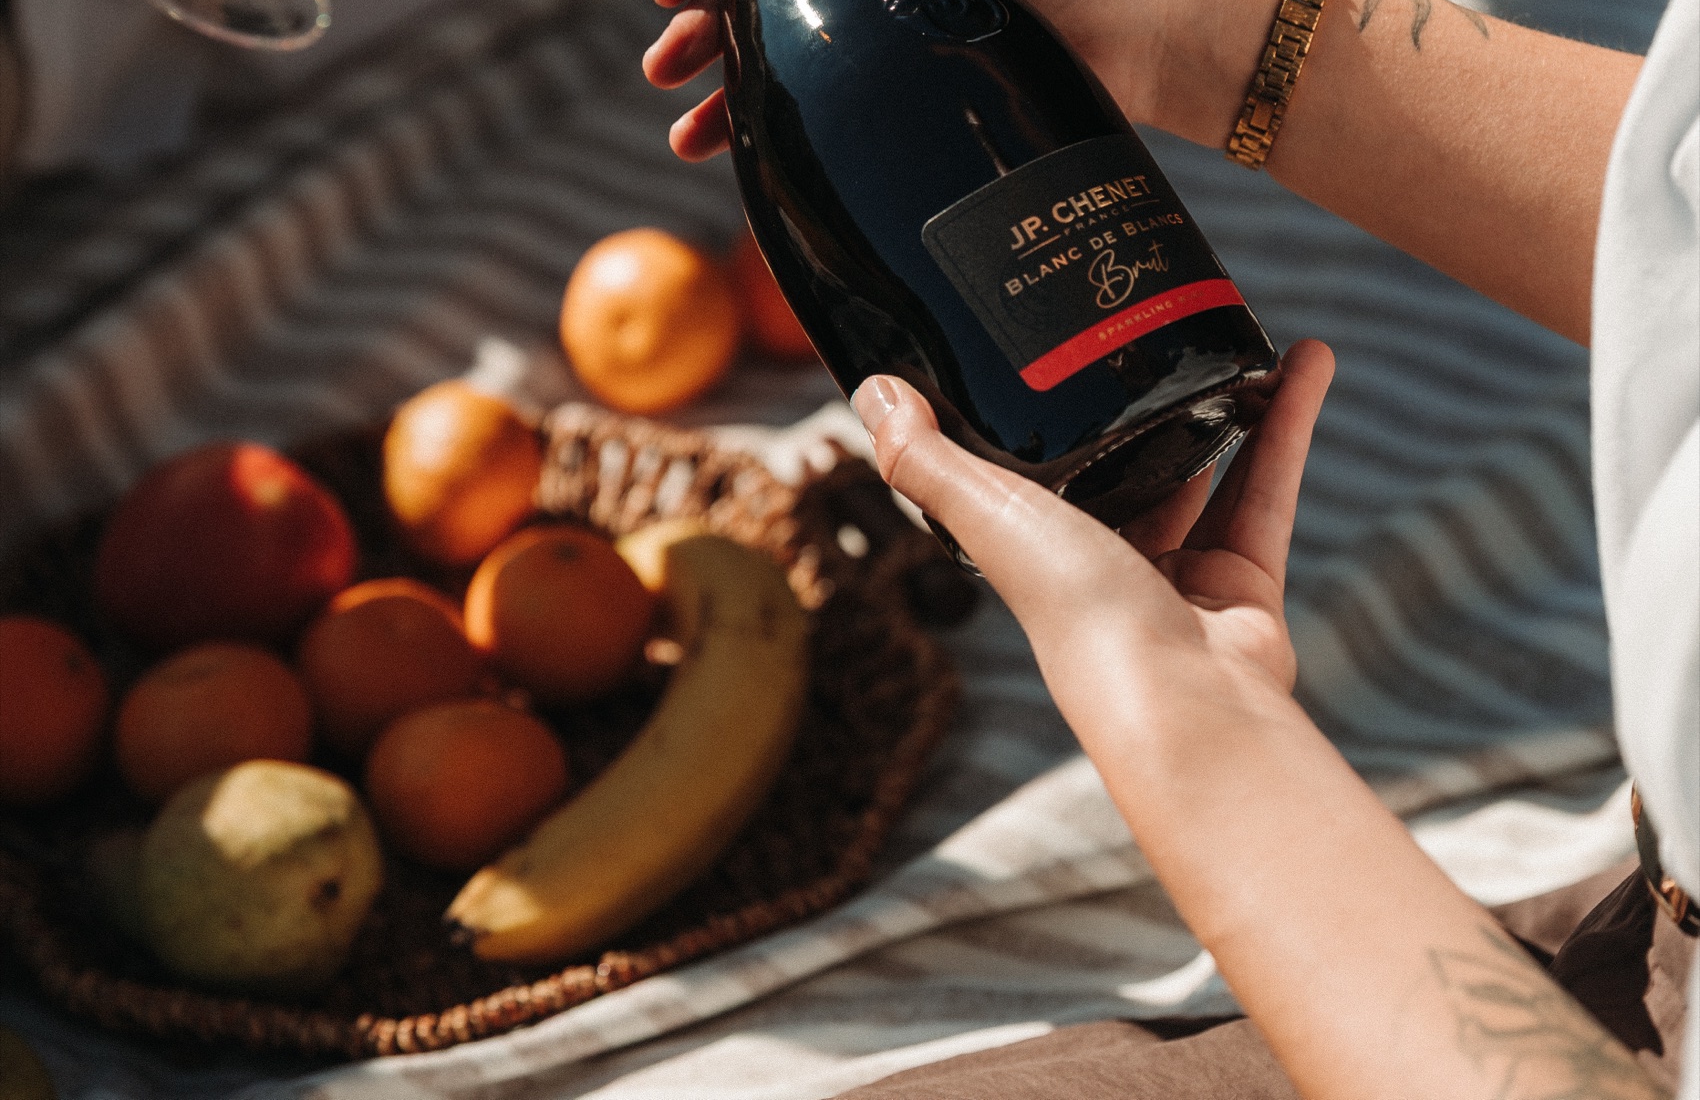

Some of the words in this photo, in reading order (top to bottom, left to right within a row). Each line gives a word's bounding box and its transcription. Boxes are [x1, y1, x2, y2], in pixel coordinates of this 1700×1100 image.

[1009, 215, 1049, 251] JP.
[1051, 174, 1151, 224] CHENET
[1063, 204, 1130, 236] FRANCE
[1004, 246, 1083, 297] BLANC
[1088, 230, 1118, 251] DE
[1121, 212, 1184, 237] BLANCS
[1087, 238, 1170, 310] Brut
[1097, 300, 1174, 341] SPARKLING
